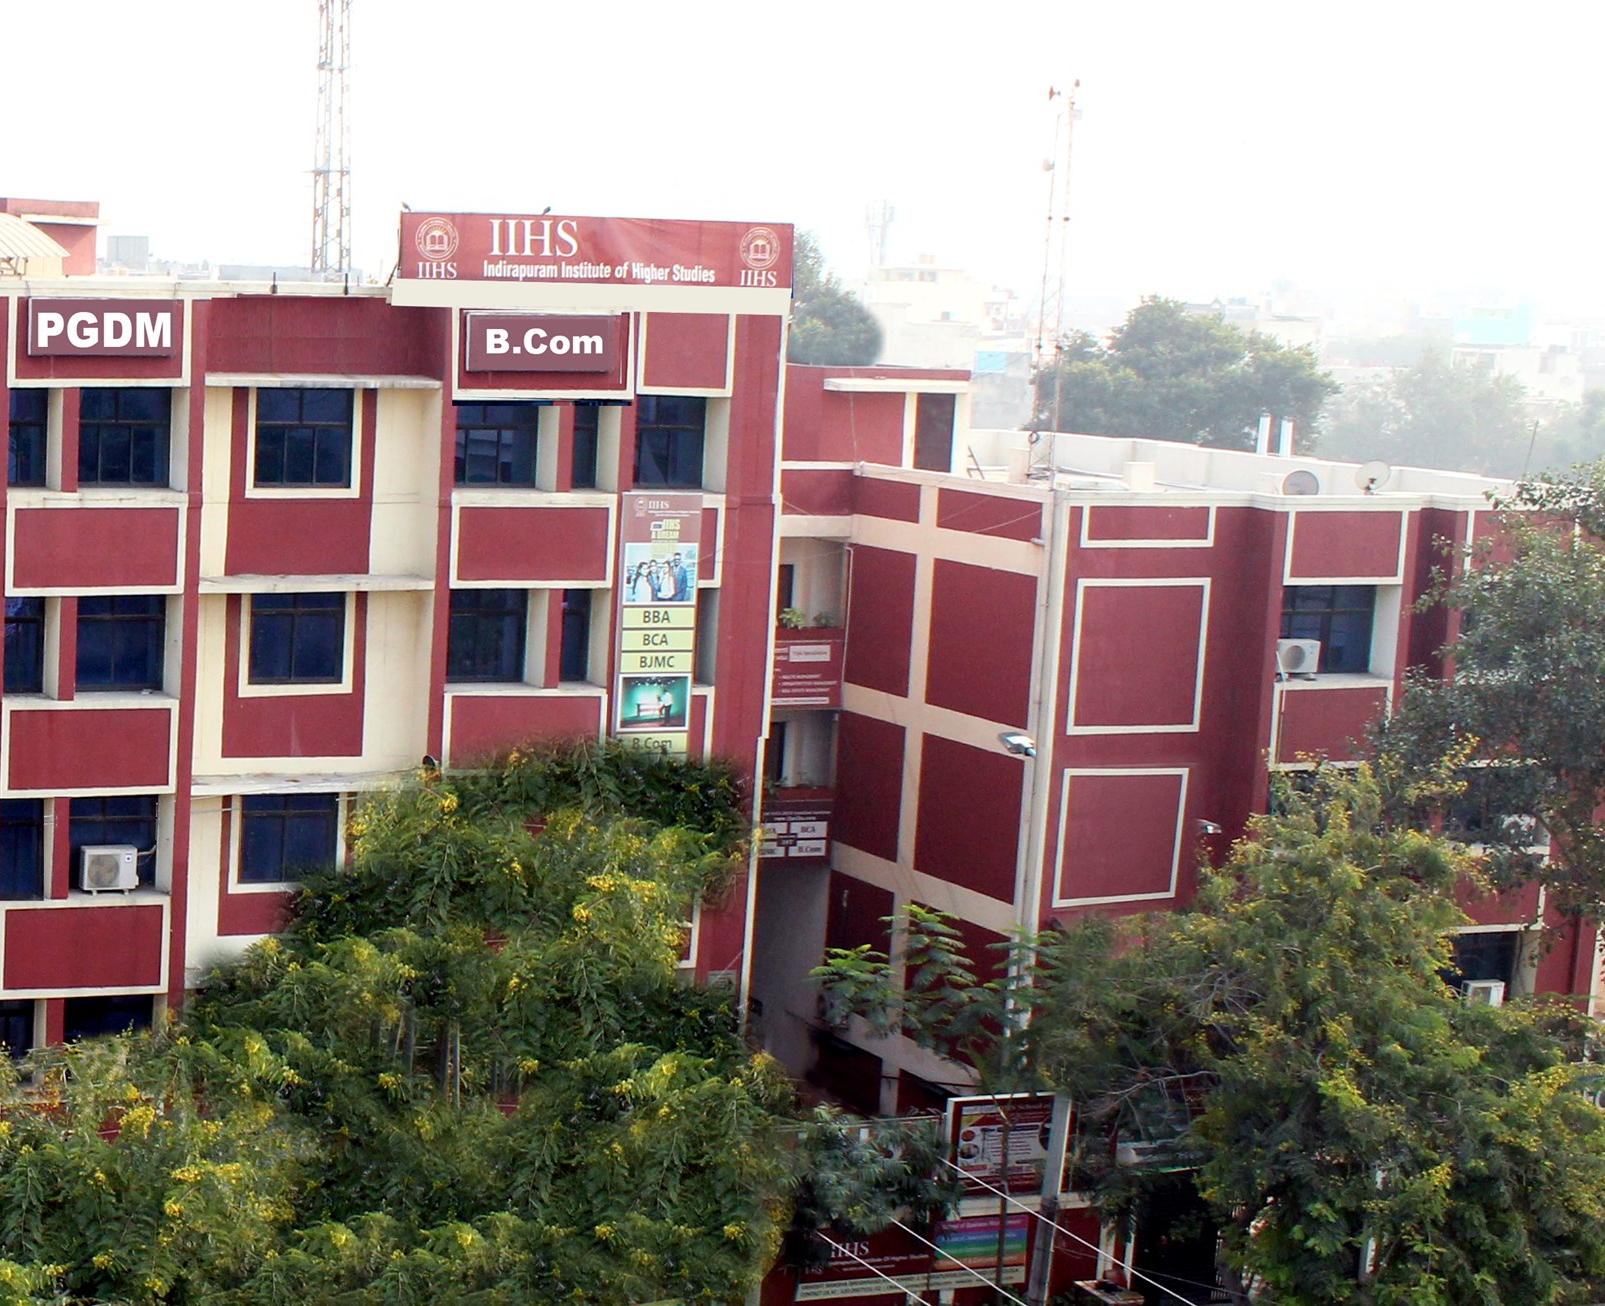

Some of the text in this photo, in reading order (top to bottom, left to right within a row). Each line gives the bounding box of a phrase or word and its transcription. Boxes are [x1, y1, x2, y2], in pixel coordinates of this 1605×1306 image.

[489, 219, 578, 257] IIHS
[417, 262, 457, 279] IIHS
[484, 260, 715, 284] Indirapuram Institute of Higher Studies
[739, 269, 777, 287] IIHS
[37, 311, 171, 347] PGDM
[486, 328, 603, 354] B.Com
[642, 610, 671, 624] BBA
[642, 633, 669, 646] BCA
[639, 655, 675, 668] BJMC
[632, 737, 672, 750] B.Com
[830, 1241, 870, 1259] IIHS
